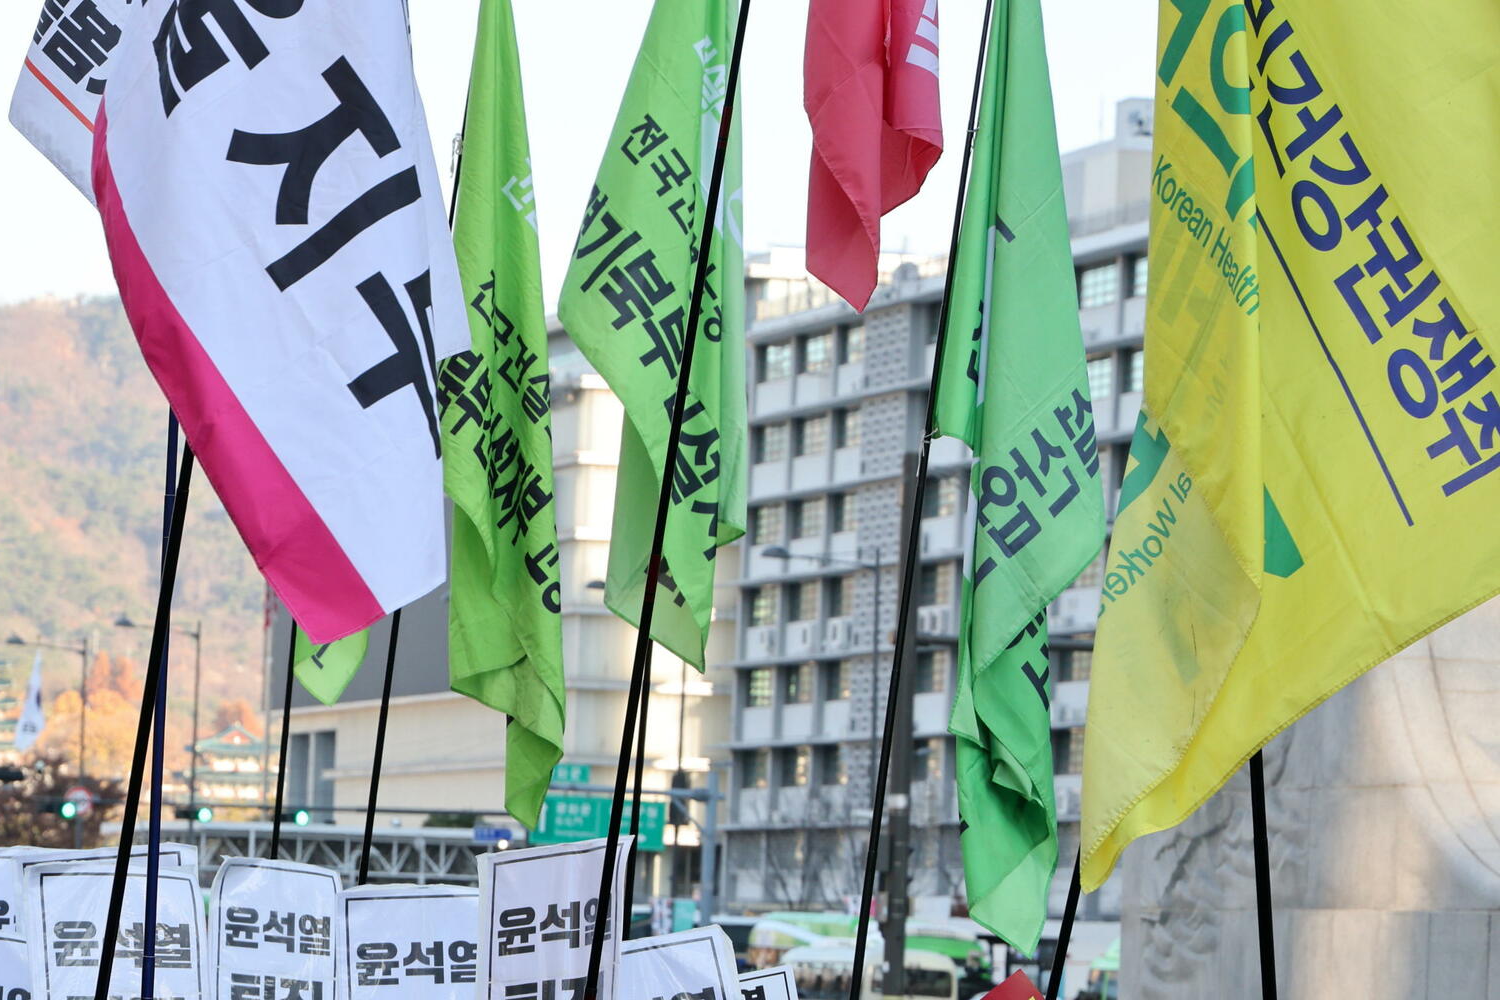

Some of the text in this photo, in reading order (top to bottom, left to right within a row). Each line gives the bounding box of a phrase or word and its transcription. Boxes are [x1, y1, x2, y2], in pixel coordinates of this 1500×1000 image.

[1152, 155, 1213, 249] Korean
[1211, 236, 1261, 316] Health
[53, 920, 193, 969] 윤석열
[225, 906, 331, 957] 윤석열
[498, 897, 613, 957] 윤석열
[356, 940, 477, 987] 윤석열
